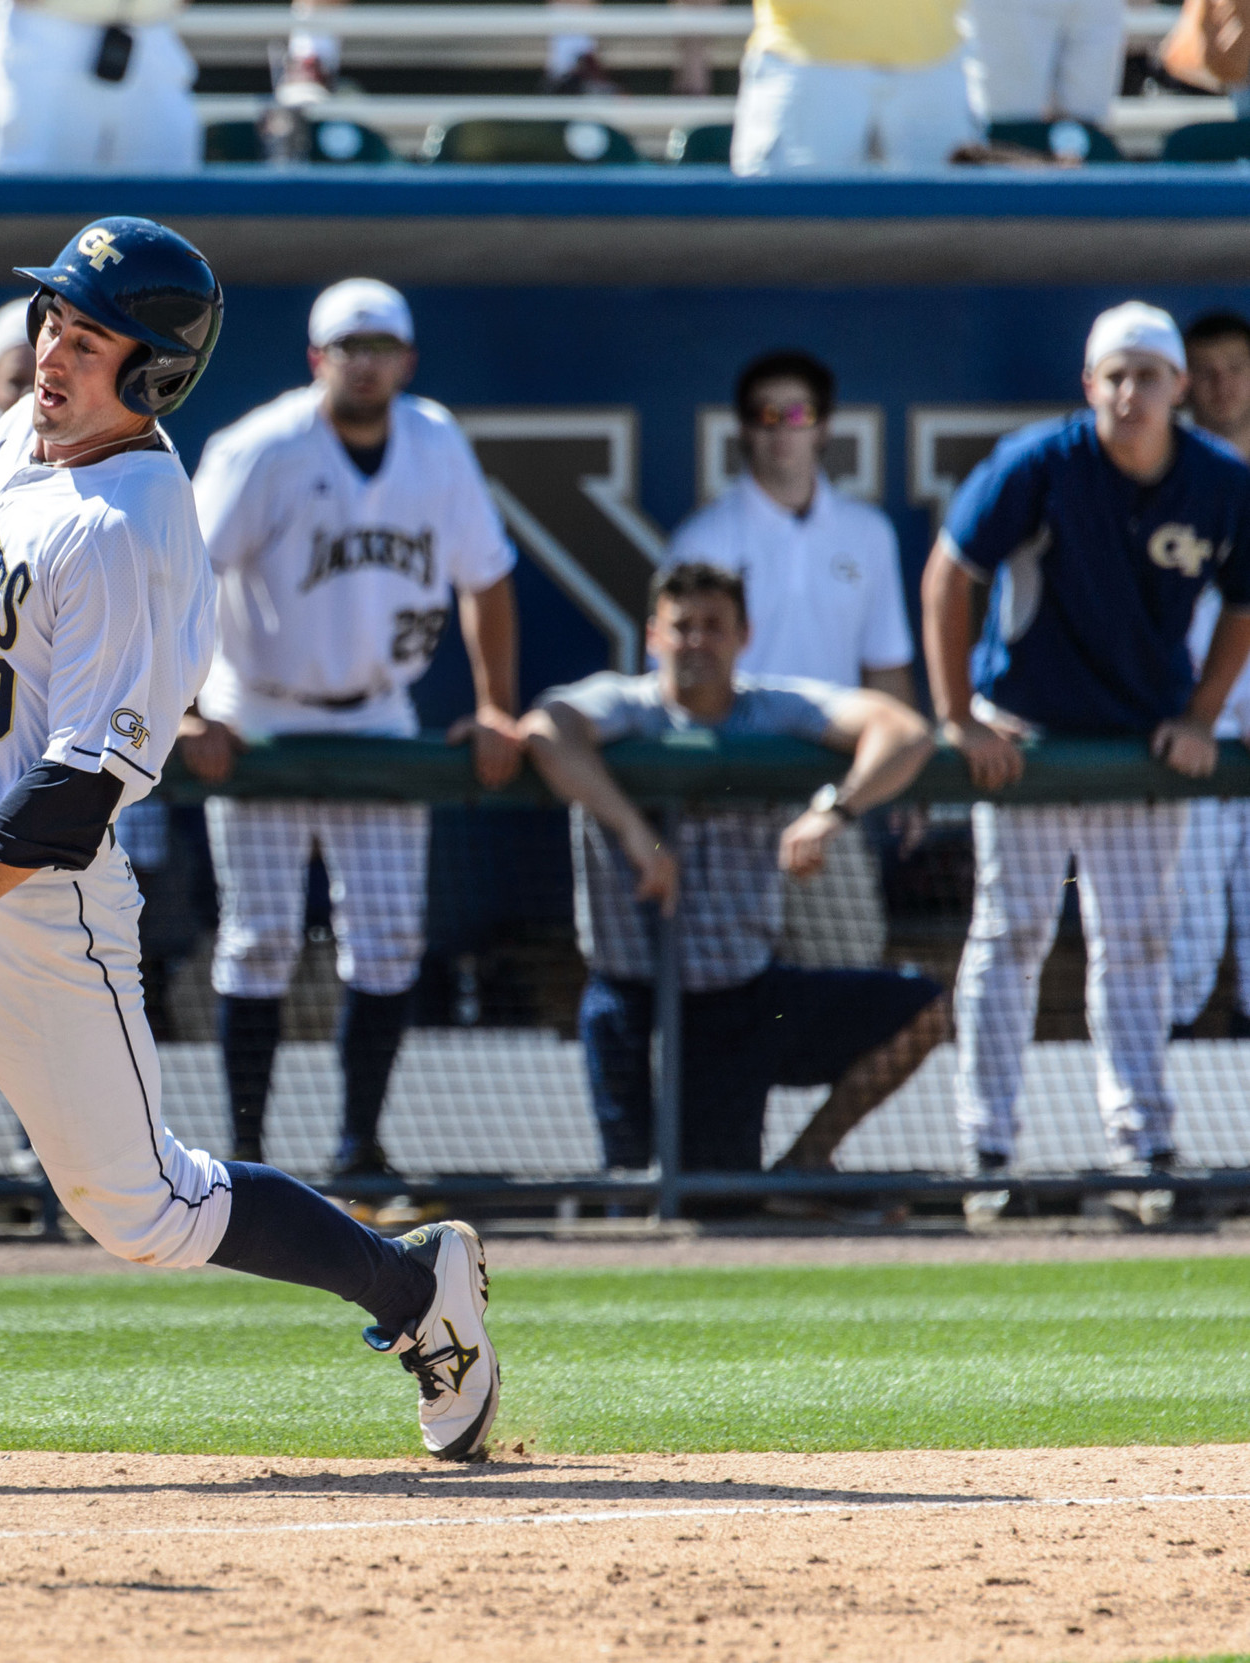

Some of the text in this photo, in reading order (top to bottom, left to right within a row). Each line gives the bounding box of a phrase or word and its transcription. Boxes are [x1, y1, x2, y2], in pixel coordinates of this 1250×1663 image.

[78, 227, 125, 272] GT
[1147, 521, 1212, 577] GT
[111, 708, 150, 749] GT
